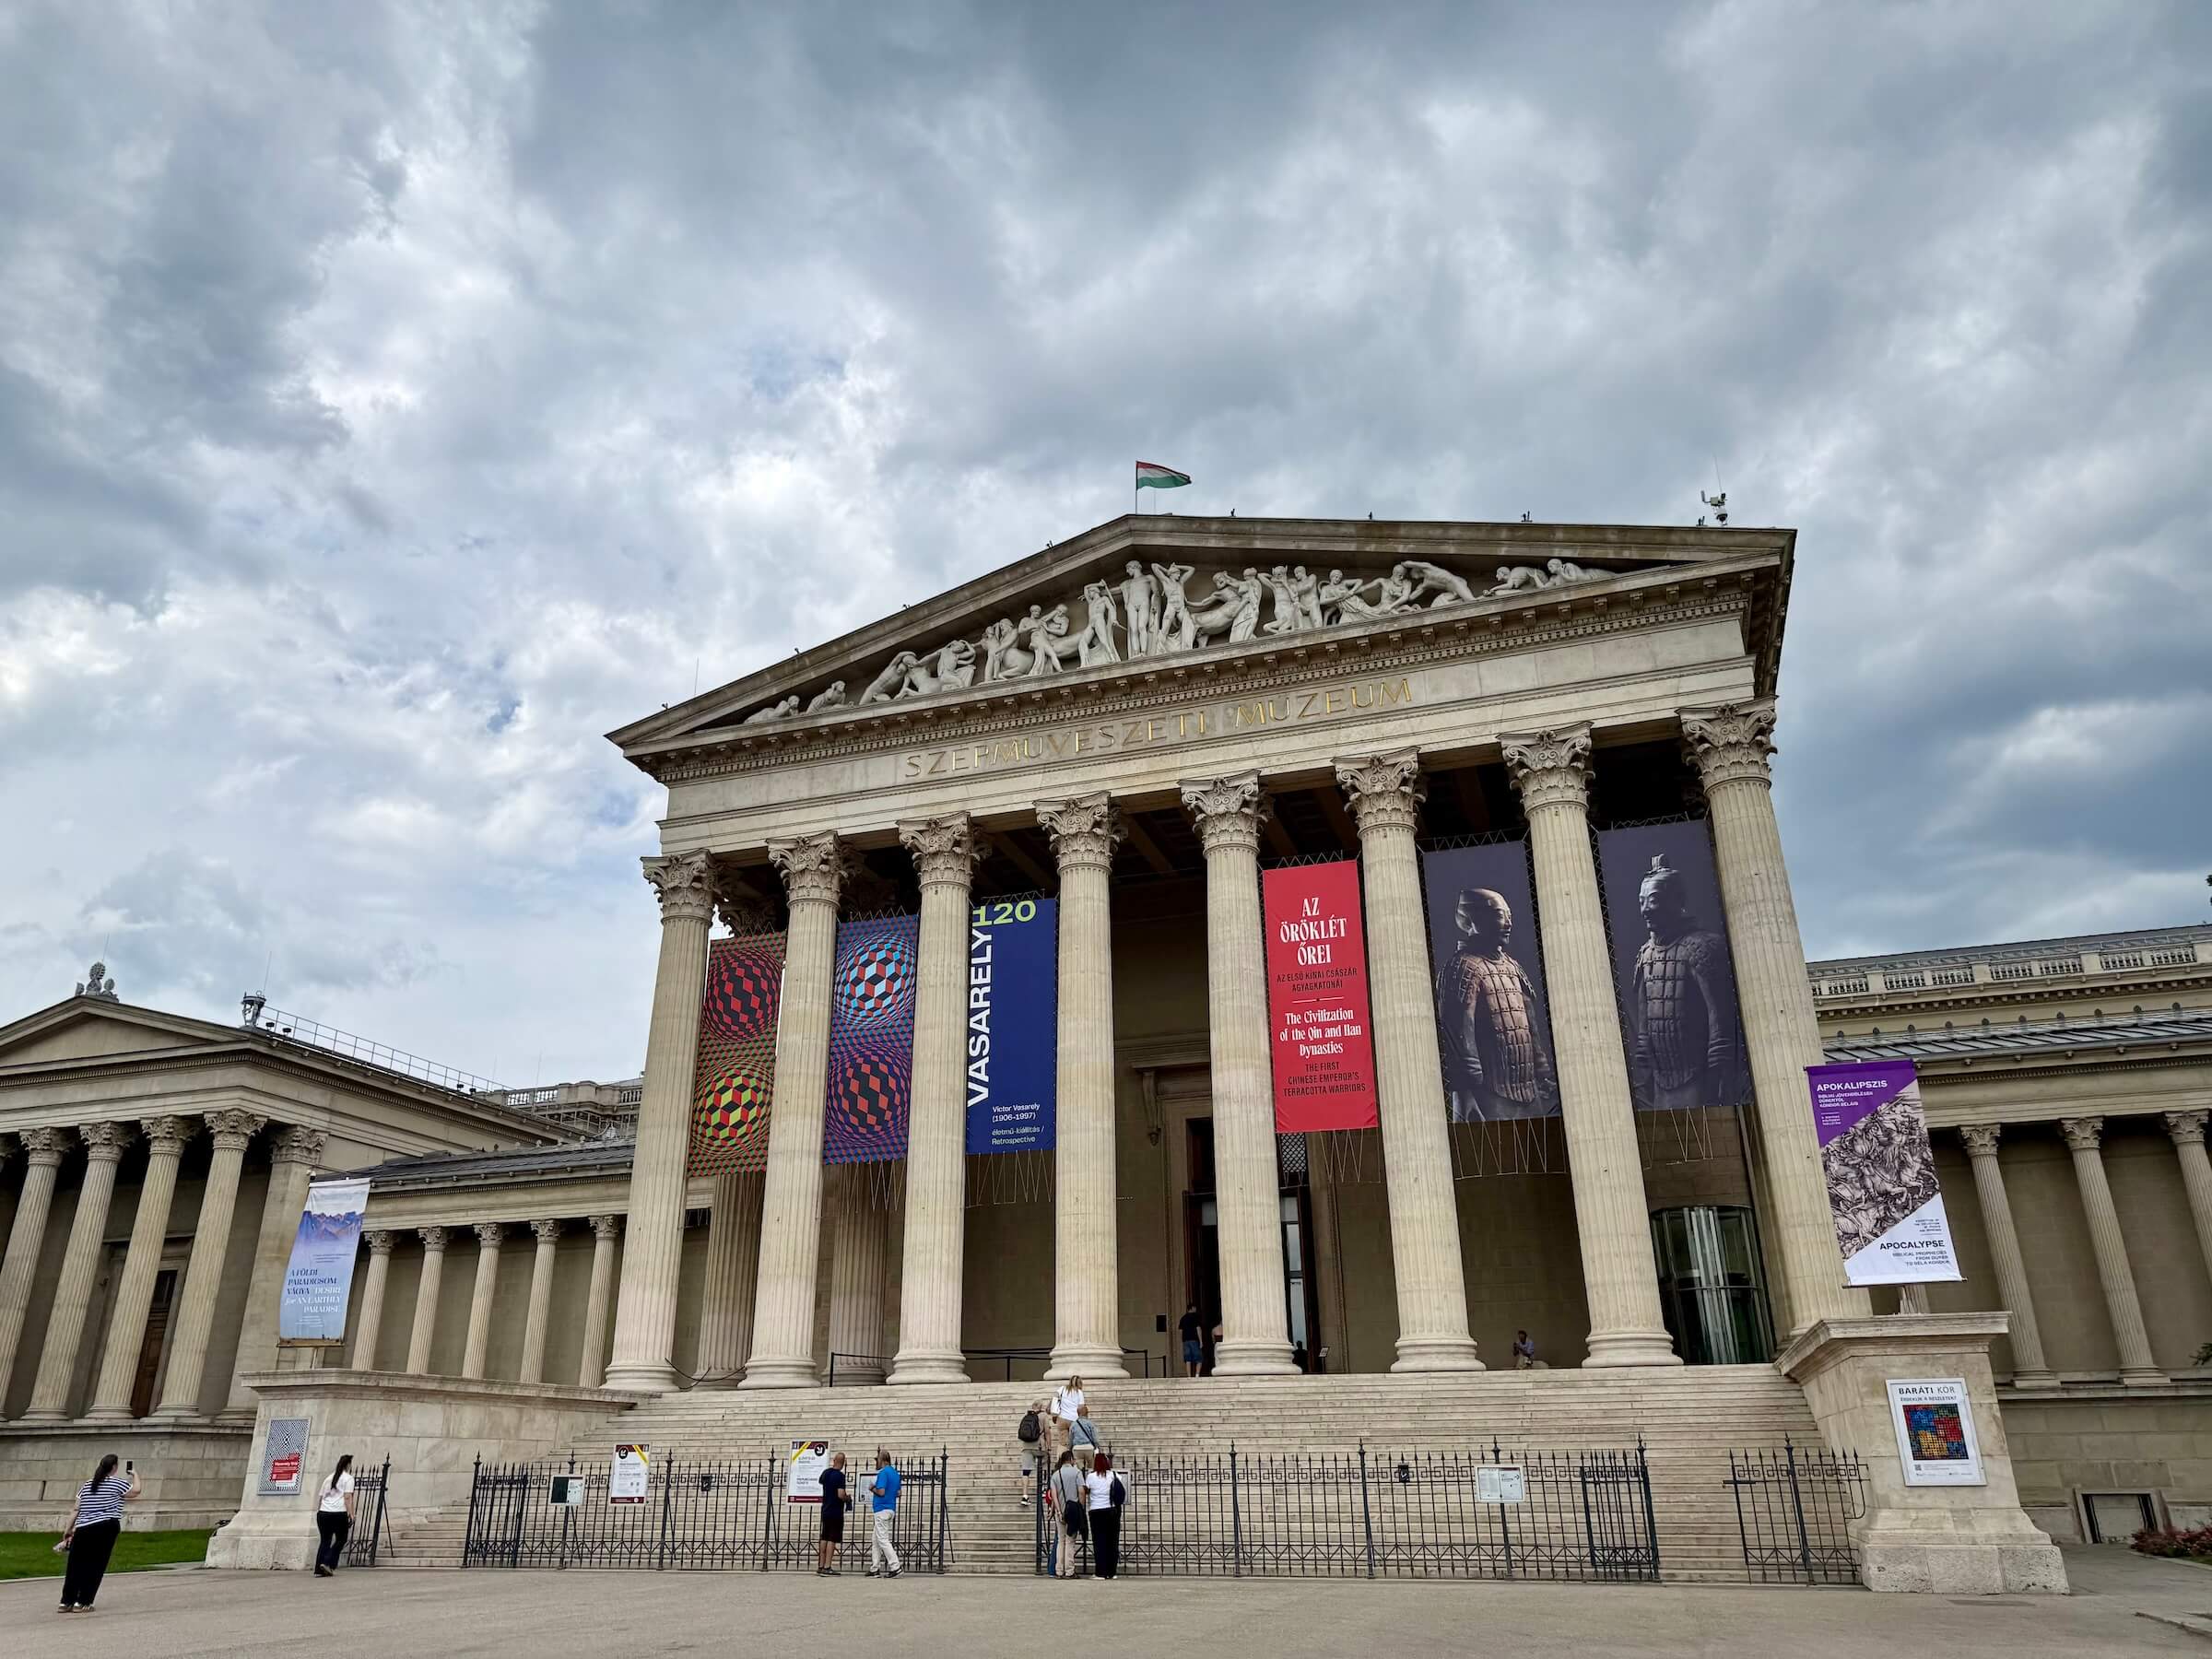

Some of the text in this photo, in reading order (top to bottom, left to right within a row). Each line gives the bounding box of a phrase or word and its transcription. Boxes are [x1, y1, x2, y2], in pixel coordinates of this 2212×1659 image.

[972, 900, 1036, 927] 120
[1302, 897, 1320, 917] AZ
[1280, 914, 1347, 943] ÖRÖKLÉT
[1297, 941, 1332, 966] ŐREI
[967, 928, 992, 1107] VASARELY
[1285, 1007, 1354, 1025] The Civilization
[1279, 1024, 1362, 1041] of the Qin and Han
[1300, 1041, 1344, 1059] Dynasties
[1305, 1061, 1339, 1072] THE FIRST
[1288, 1071, 1359, 1085] CHINESE EMPEROR'S
[1283, 1083, 1366, 1097] TERRACOTTA WARRIORS
[1817, 1079, 1888, 1092] APOKALIPSZIS
[1013, 1102, 1041, 1112] Vasarely
[992, 1112, 1036, 1123] (1906-1997)
[991, 1136, 1036, 1145] Retrospective
[1880, 1240, 1945, 1251] APOCALYPSE
[1899, 1385, 1934, 1394] BARÁTI
